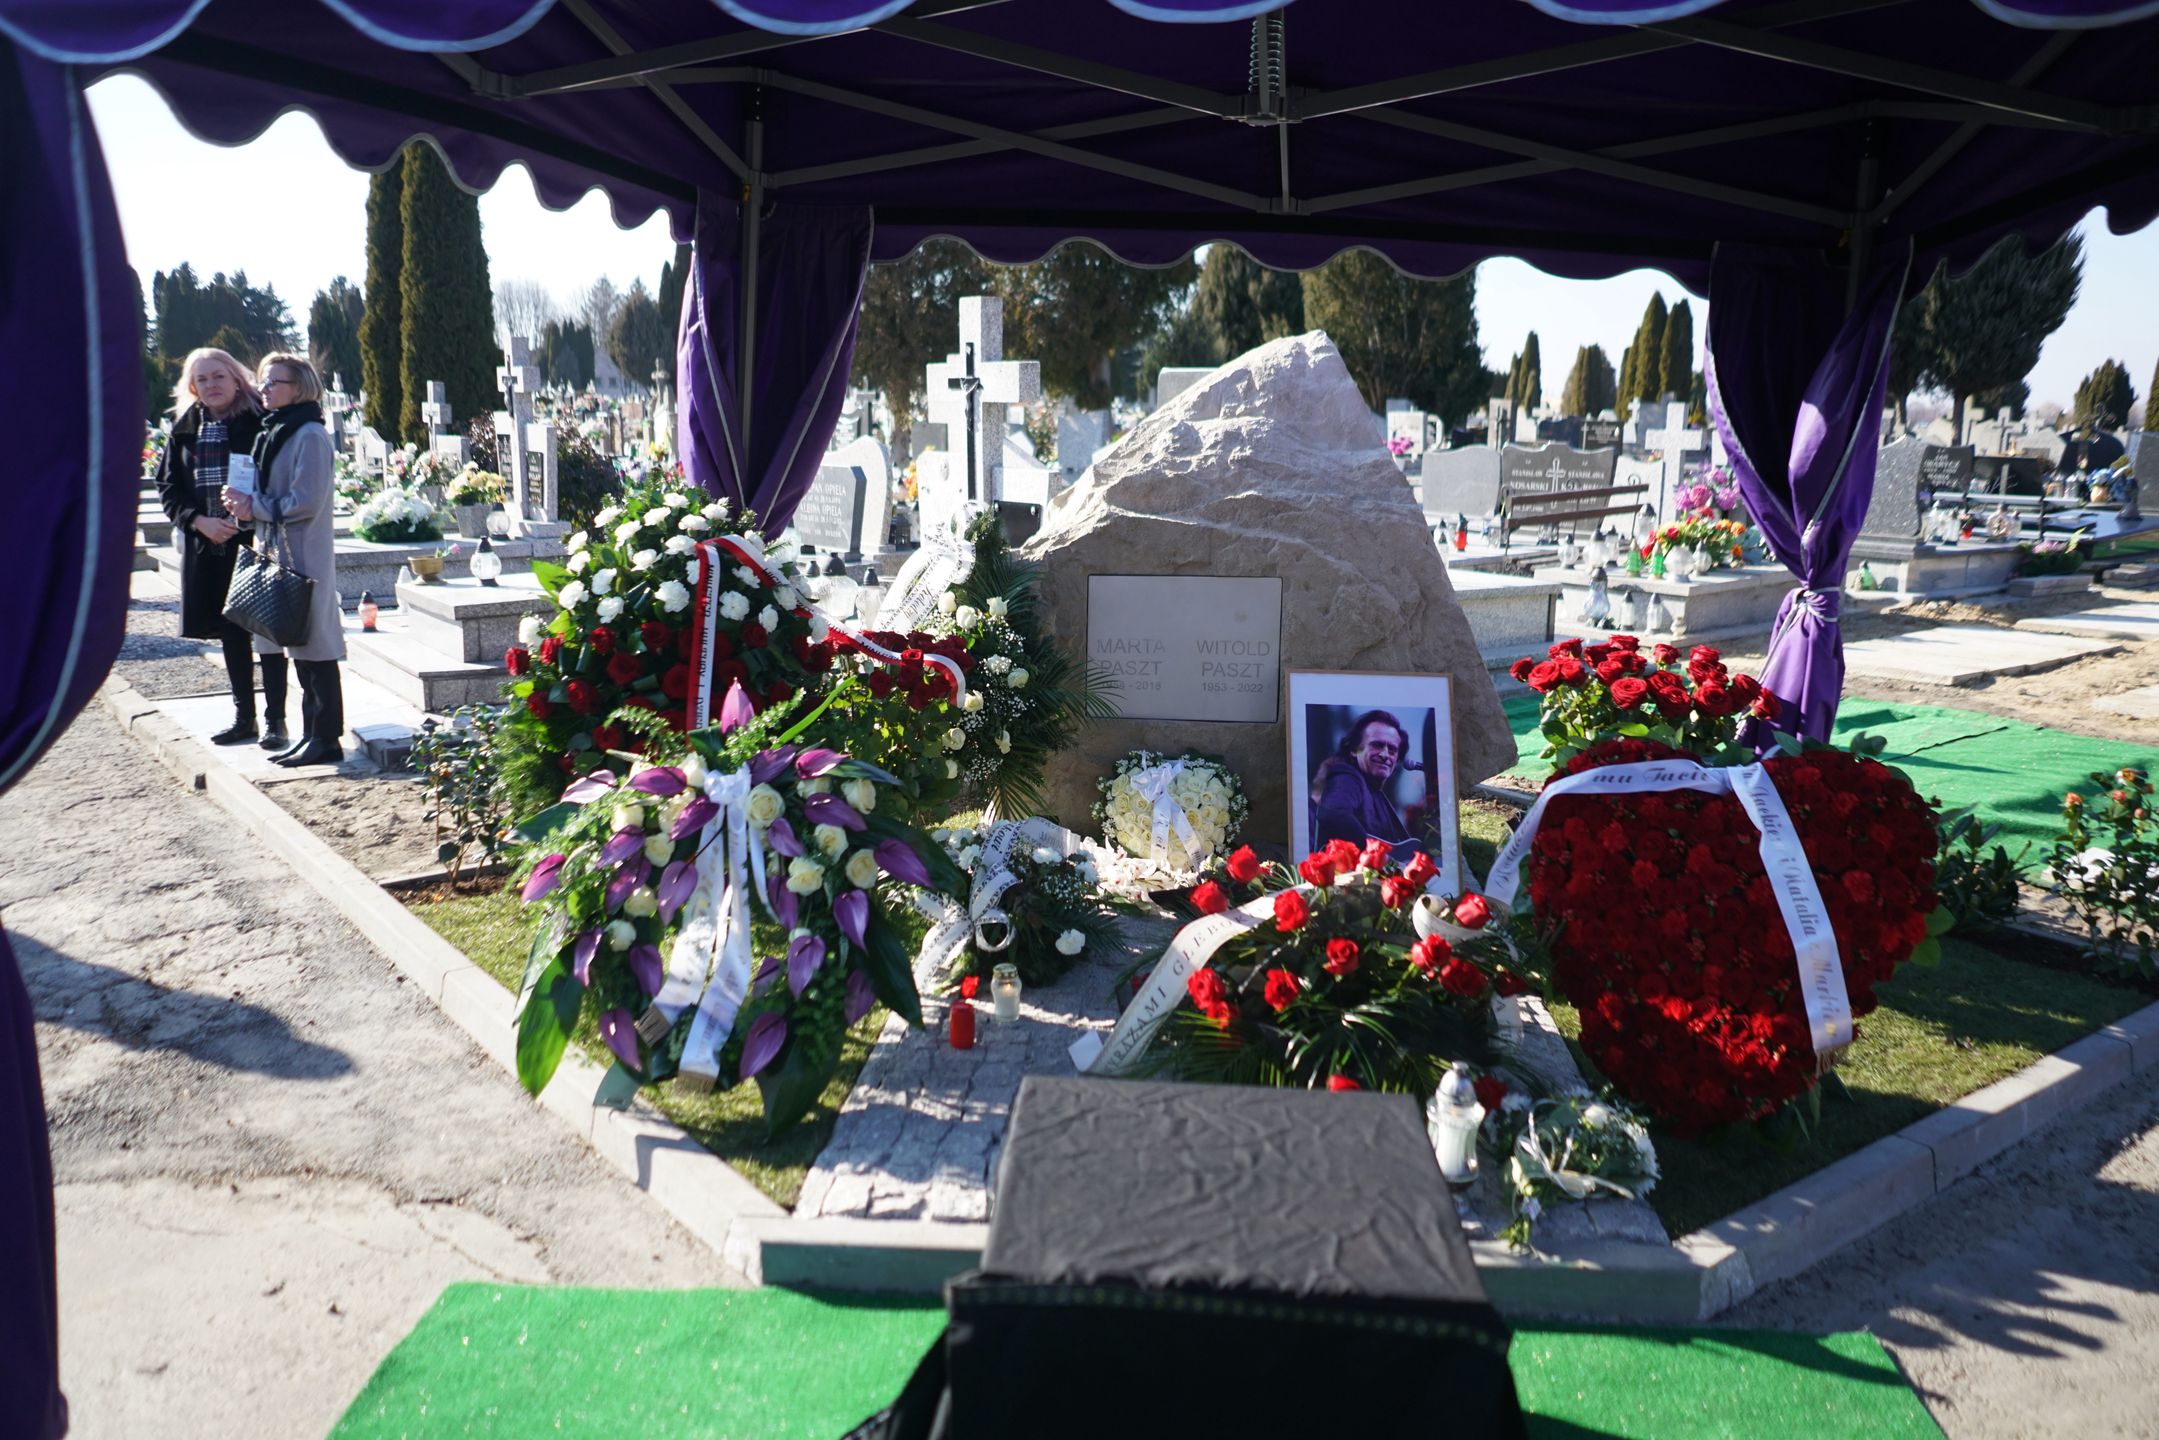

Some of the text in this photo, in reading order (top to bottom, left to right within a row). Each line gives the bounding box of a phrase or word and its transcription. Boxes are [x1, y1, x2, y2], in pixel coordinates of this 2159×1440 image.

[1097, 638, 1166, 655] MARTA
[1196, 640, 1271, 657] WITOLD
[1100, 660, 1163, 676] PASZT
[1201, 662, 1265, 679] PASZT
[1135, 680, 1162, 691] 2018
[1202, 682, 1227, 692] 1953
[1237, 682, 1264, 694] 2022
